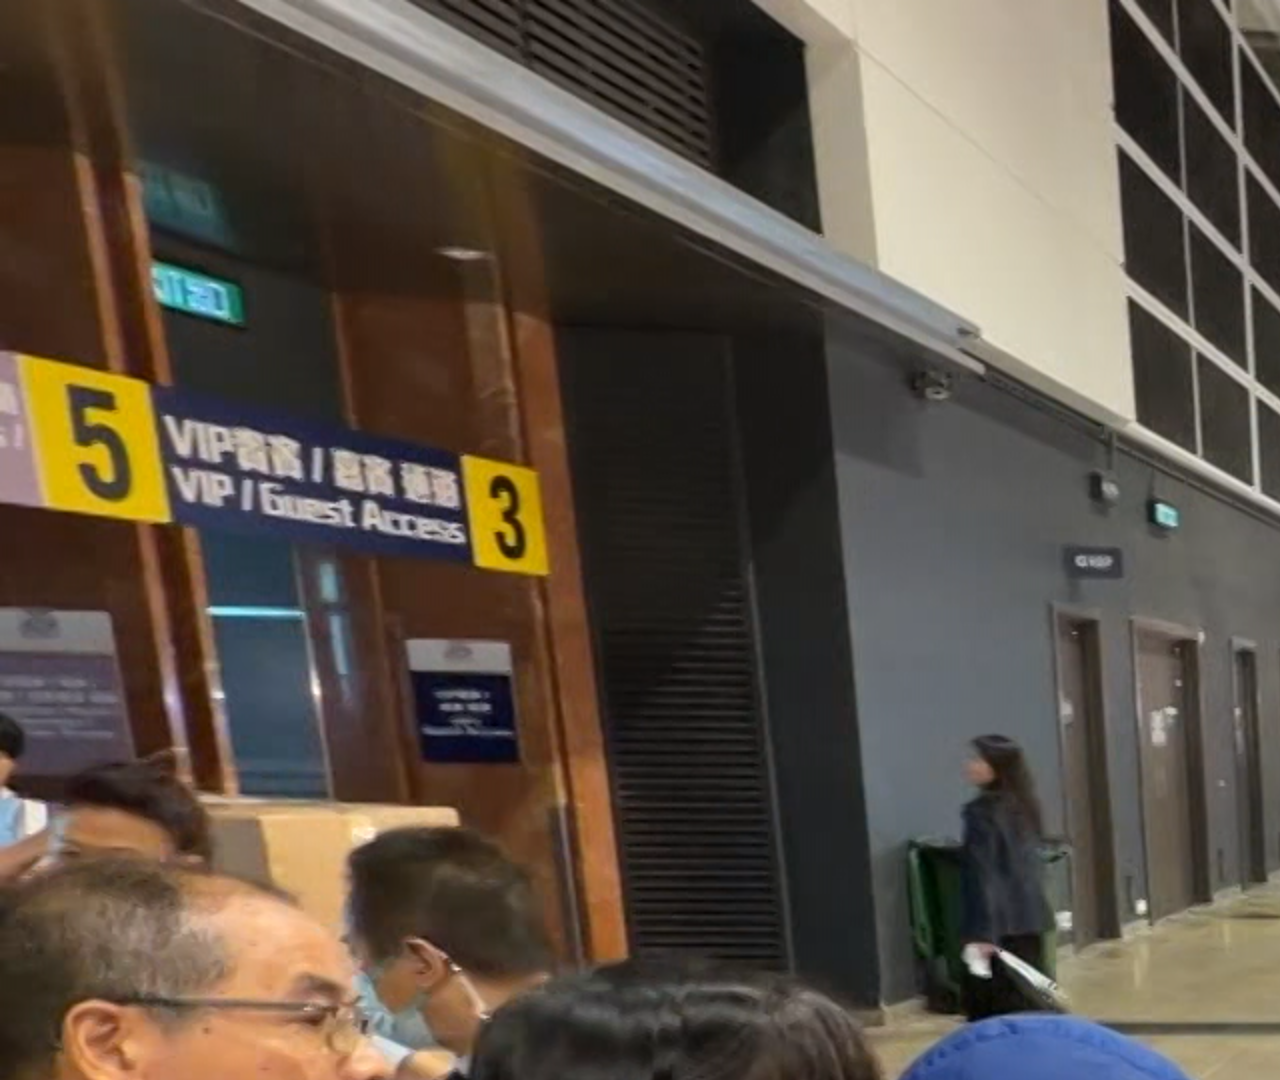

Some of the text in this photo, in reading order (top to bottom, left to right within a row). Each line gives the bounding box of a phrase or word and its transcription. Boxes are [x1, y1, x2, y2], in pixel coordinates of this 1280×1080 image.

[66, 382, 132, 503] 5
[170, 464, 235, 508] VIP
[258, 481, 358, 529] Guest
[361, 498, 467, 546] Access
[489, 474, 526, 561] 3
